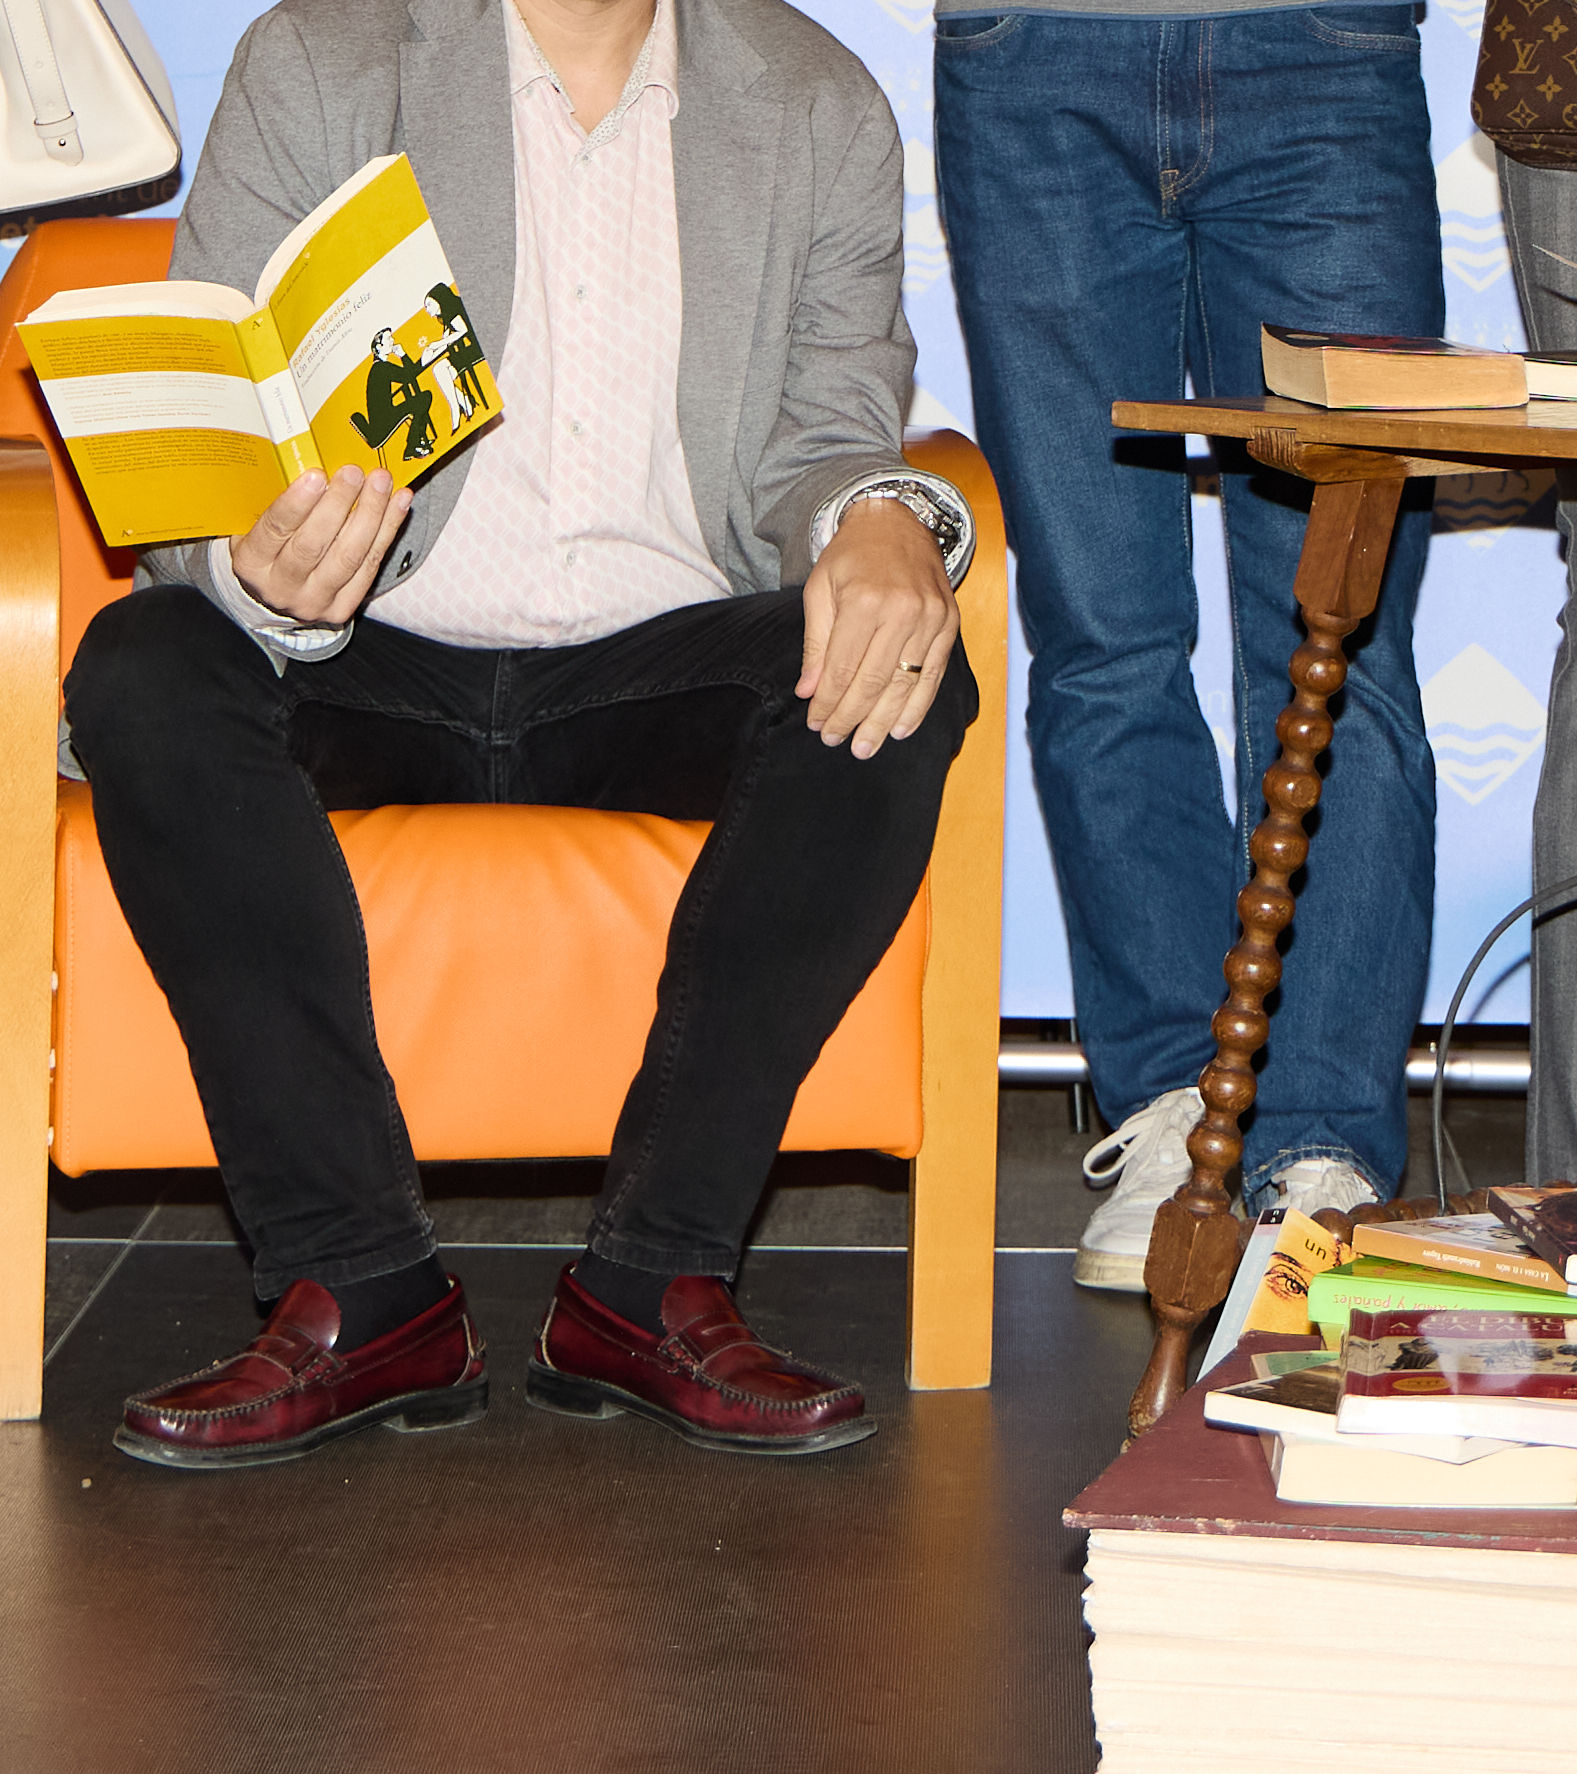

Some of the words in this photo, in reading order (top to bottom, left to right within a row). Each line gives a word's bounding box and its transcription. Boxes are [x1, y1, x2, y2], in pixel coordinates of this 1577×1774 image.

[307, 311, 352, 364] matrimonio
[352, 291, 373, 313] feliz
[1304, 1237, 1327, 1261] un
